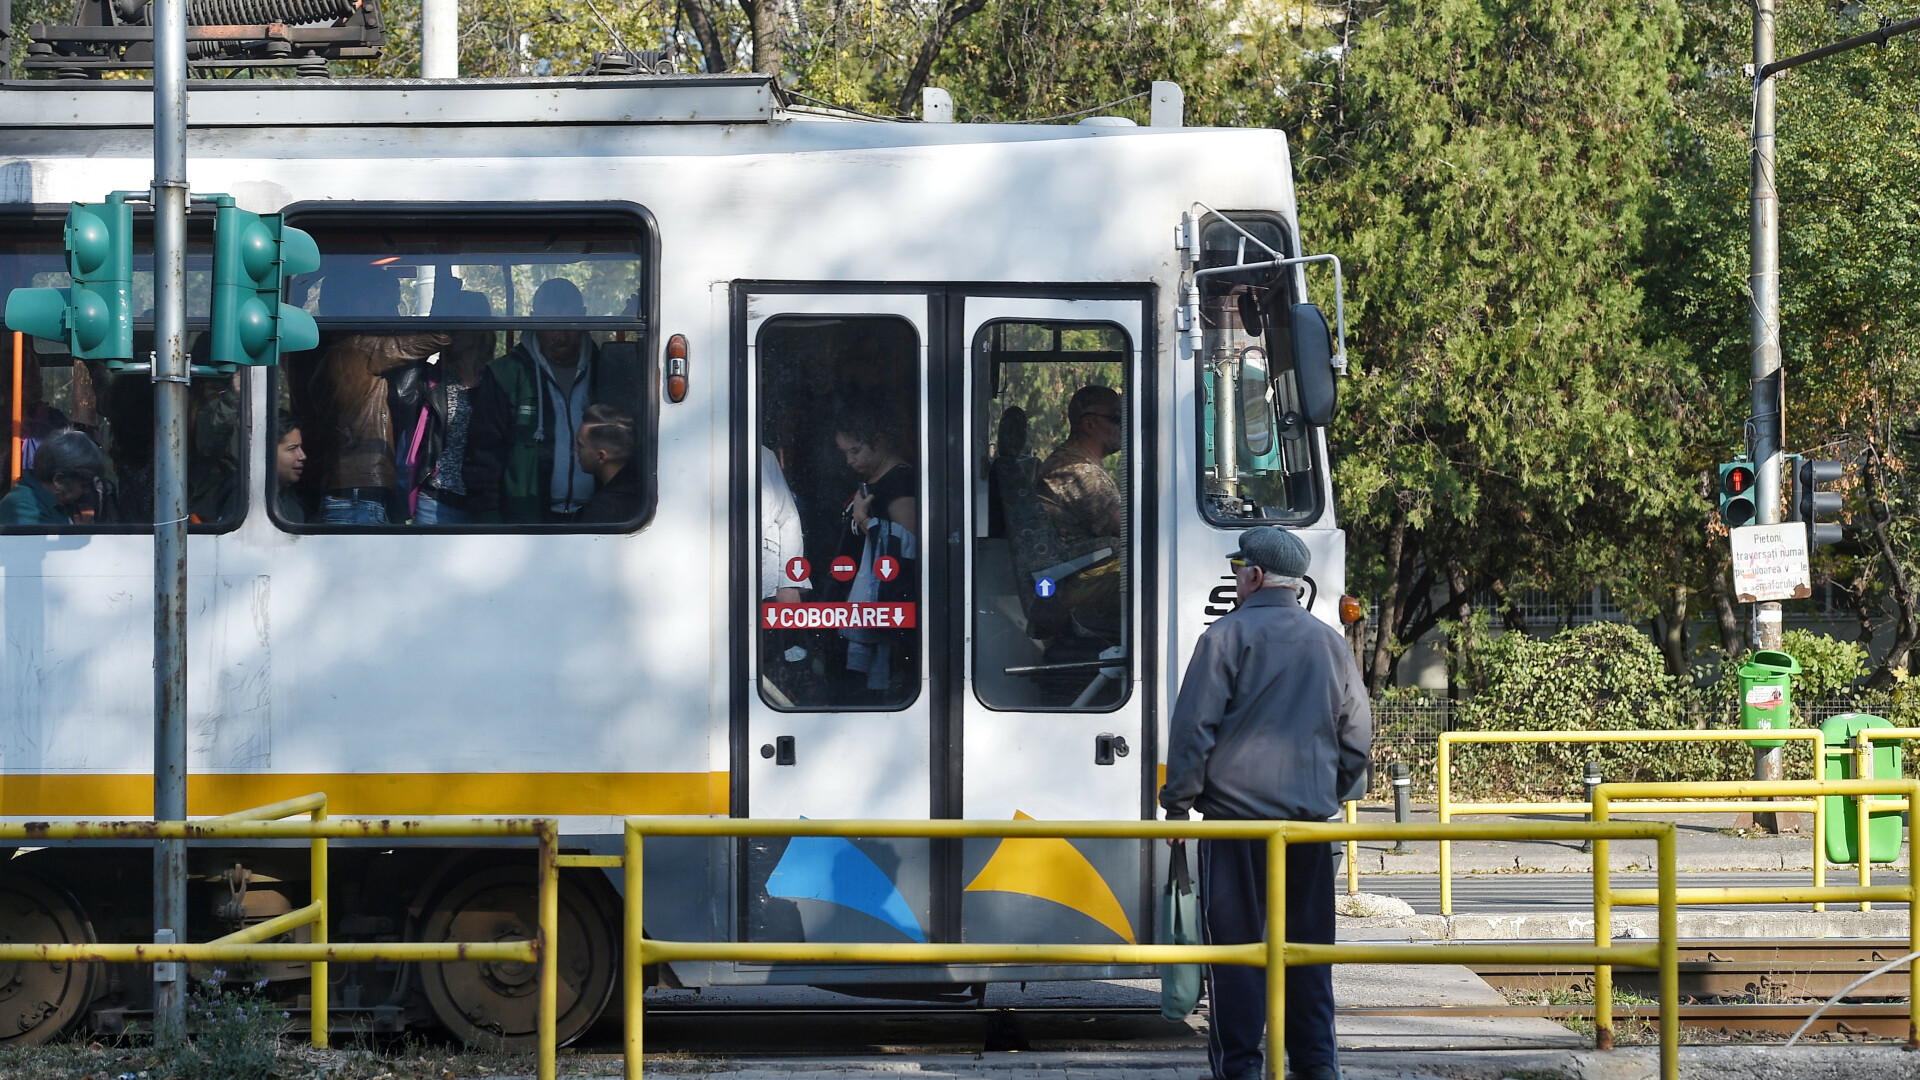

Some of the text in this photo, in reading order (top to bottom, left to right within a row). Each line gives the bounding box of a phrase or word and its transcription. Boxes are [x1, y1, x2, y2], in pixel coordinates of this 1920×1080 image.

[1753, 531, 1784, 544] Pietoni,
[1780, 545, 1805, 557] numai
[1747, 563, 1782, 576] uloarea
[780, 603, 890, 627] COBORÂRE
